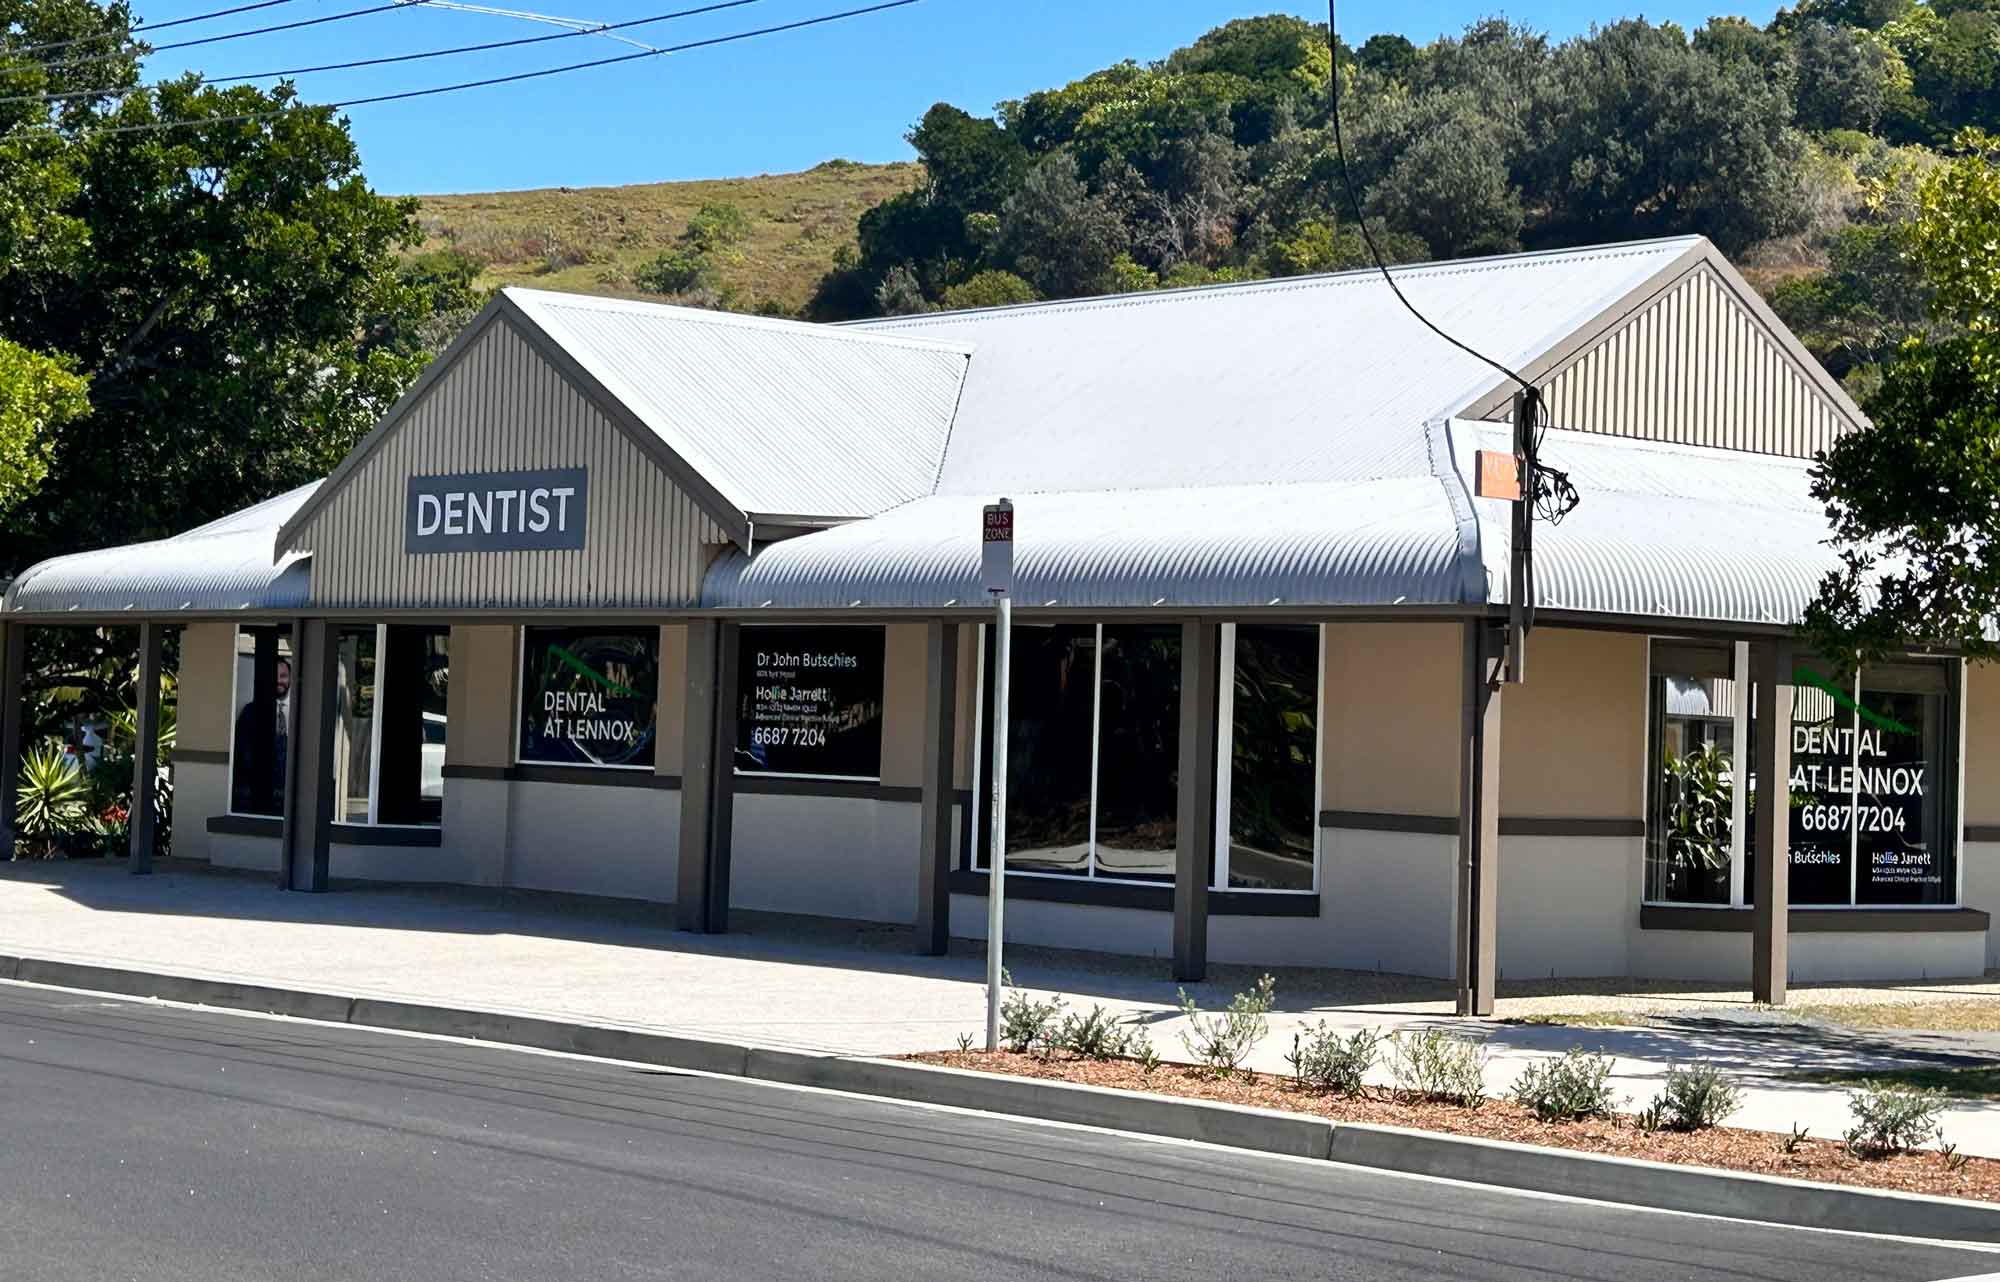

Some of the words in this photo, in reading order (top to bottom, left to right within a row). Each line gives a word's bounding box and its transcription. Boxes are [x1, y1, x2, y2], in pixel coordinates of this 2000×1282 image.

[417, 487, 575, 536] DENTIST
[986, 512, 1009, 526] BUS
[985, 527, 1009, 540] ZONE
[757, 652, 770, 667] Dr
[773, 652, 800, 667] John
[803, 652, 857, 668] Butschies
[544, 691, 607, 712] DENTAL
[756, 686, 787, 700] Hollie
[789, 686, 827, 701] Jarrett
[543, 717, 564, 739] AT
[567, 719, 634, 741] LENNOX
[755, 727, 789, 744] 6687
[792, 728, 826, 746] 7204
[1793, 726, 1887, 757] DENTAL
[1791, 764, 1821, 793] AT
[1828, 766, 1924, 796] LENNOX
[1802, 804, 1852, 831] 6687
[1858, 806, 1906, 833] 7204
